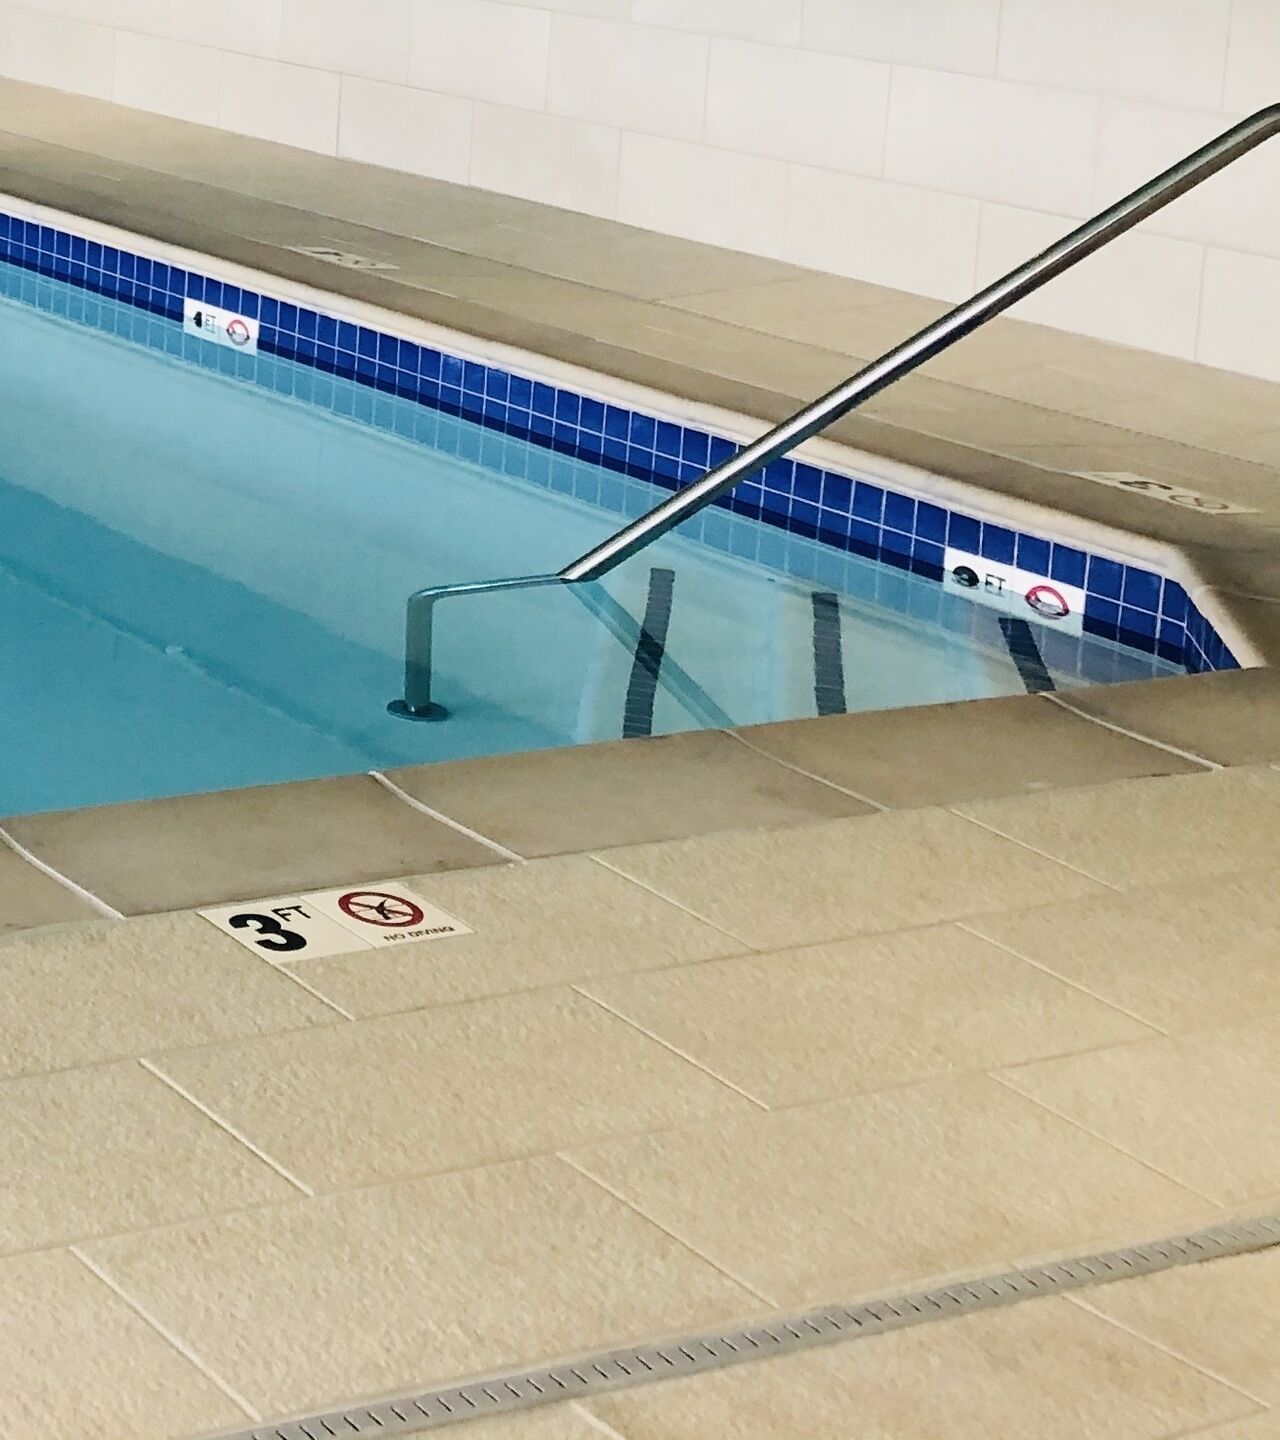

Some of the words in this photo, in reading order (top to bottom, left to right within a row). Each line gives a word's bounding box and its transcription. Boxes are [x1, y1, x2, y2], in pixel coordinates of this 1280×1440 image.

[228, 913, 308, 952] 3
[271, 905, 312, 922] FT
[383, 933, 406, 942] NO
[407, 926, 455, 937] DIVING
